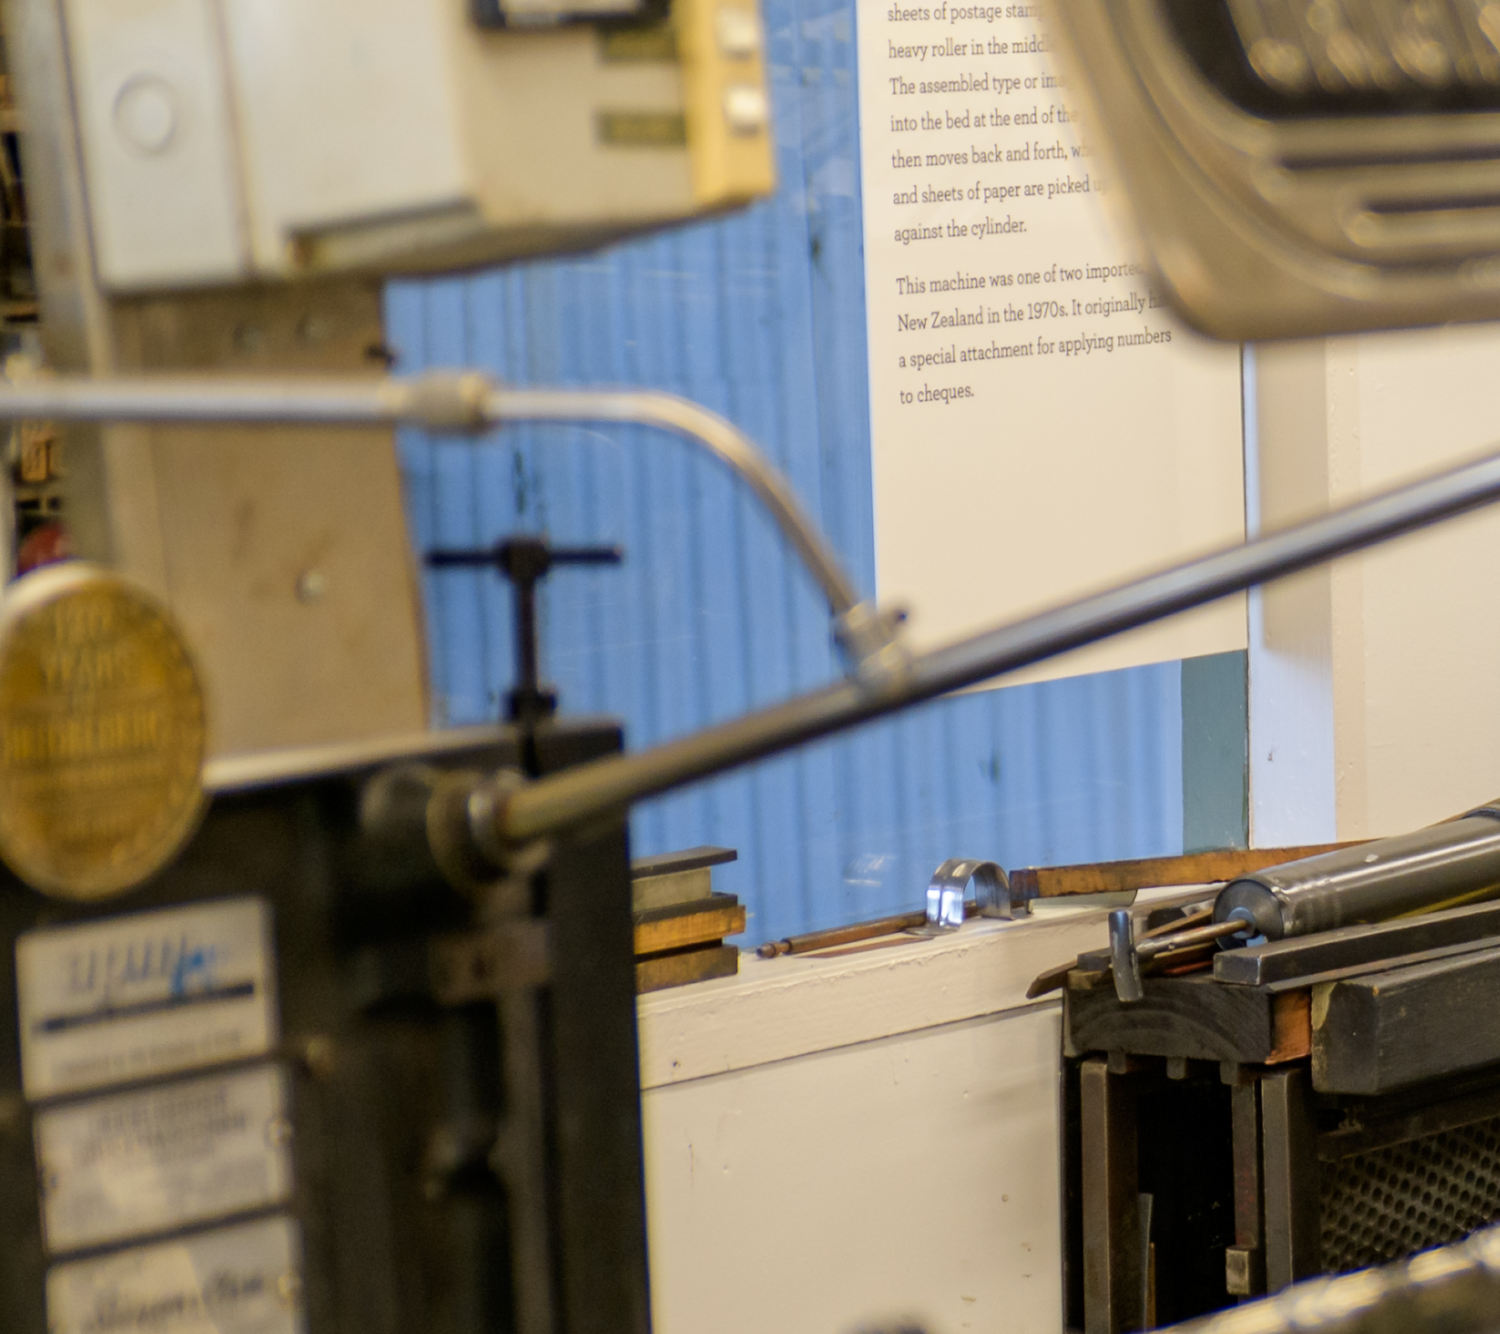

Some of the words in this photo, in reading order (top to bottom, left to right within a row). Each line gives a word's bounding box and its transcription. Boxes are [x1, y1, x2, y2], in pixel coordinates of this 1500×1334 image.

[888, 3, 930, 22] sheets
[934, 1, 947, 20] of
[950, 6, 1002, 24] postage
[889, 40, 928, 61] heavy
[932, 38, 967, 57] roller
[971, 38, 984, 56] in
[987, 36, 1008, 54] the
[889, 76, 915, 95] The
[919, 72, 989, 94] assembled
[992, 77, 1021, 94] type
[1024, 77, 1038, 89] or
[891, 116, 917, 132] into
[921, 111, 942, 130] the
[946, 109, 970, 129] bed
[974, 111, 986, 127] at
[990, 108, 1011, 126] the
[1014, 106, 1038, 125] end
[1042, 105, 1054, 124] of
[892, 150, 922, 168] then
[926, 153, 968, 166] moves
[971, 144, 1002, 164] back
[1006, 142, 1030, 162] and
[1034, 141, 1067, 160] forth,
[893, 185, 918, 205] and
[922, 184, 963, 203] sheets
[967, 181, 980, 200] of
[983, 186, 1021, 203] paper
[1024, 184, 1044, 196] are
[1048, 175, 1090, 199] picked
[894, 226, 943, 245] against
[947, 219, 968, 237] the
[971, 215, 1027, 240] cylinder.
[896, 275, 926, 295] This
[930, 272, 986, 292] machine
[989, 274, 1013, 287] was
[1017, 272, 1040, 285] one
[1044, 263, 1056, 283] of
[1059, 267, 1083, 282] two
[898, 314, 928, 332] New
[931, 306, 984, 329] Zealand
[988, 308, 1000, 324] in
[1003, 303, 1024, 322] the
[1028, 301, 1068, 320] 1970s.
[1072, 299, 1081, 316] It
[1085, 293, 1145, 317] originally
[899, 356, 907, 368] a
[910, 344, 956, 371] special
[960, 341, 1033, 362] attachment
[1037, 336, 1055, 355] for
[1059, 333, 1114, 356] applying
[1117, 326, 1171, 347] numbers
[900, 391, 913, 404] to
[917, 383, 974, 406] cheques.
